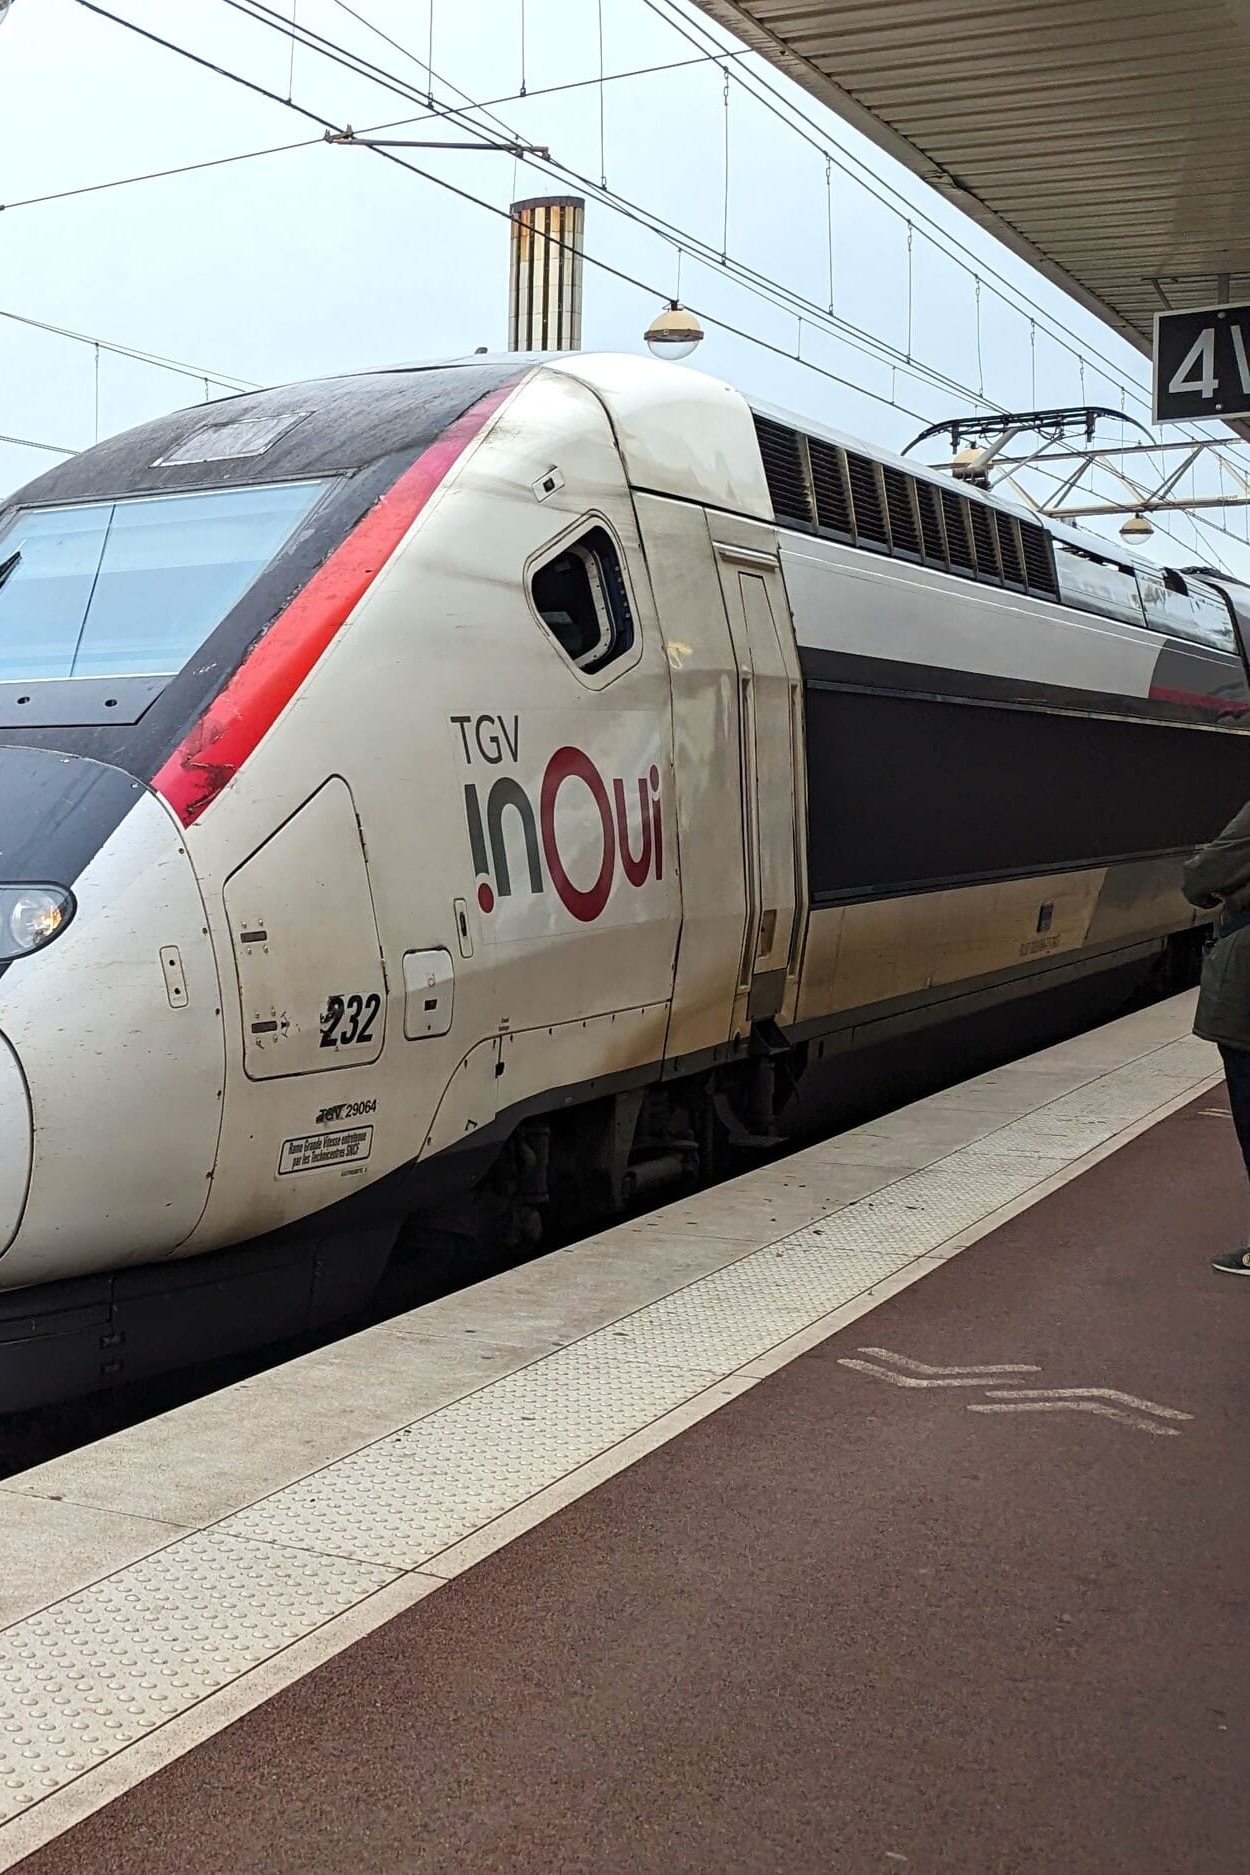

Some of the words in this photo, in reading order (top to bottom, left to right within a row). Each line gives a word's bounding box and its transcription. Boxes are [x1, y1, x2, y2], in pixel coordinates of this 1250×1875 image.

[450, 715, 518, 764] TGV
[320, 994, 381, 1047] 232
[345, 1099, 377, 1118] 29064
[288, 1142, 303, 1155] Rame
[304, 1138, 322, 1152] Grande
[323, 1136, 341, 1148] Vitesse
[292, 1157, 302, 1170] par
[302, 1154, 310, 1165] les
[311, 1148, 345, 1163] Technicentres
[346, 1143, 360, 1156] SNCF
